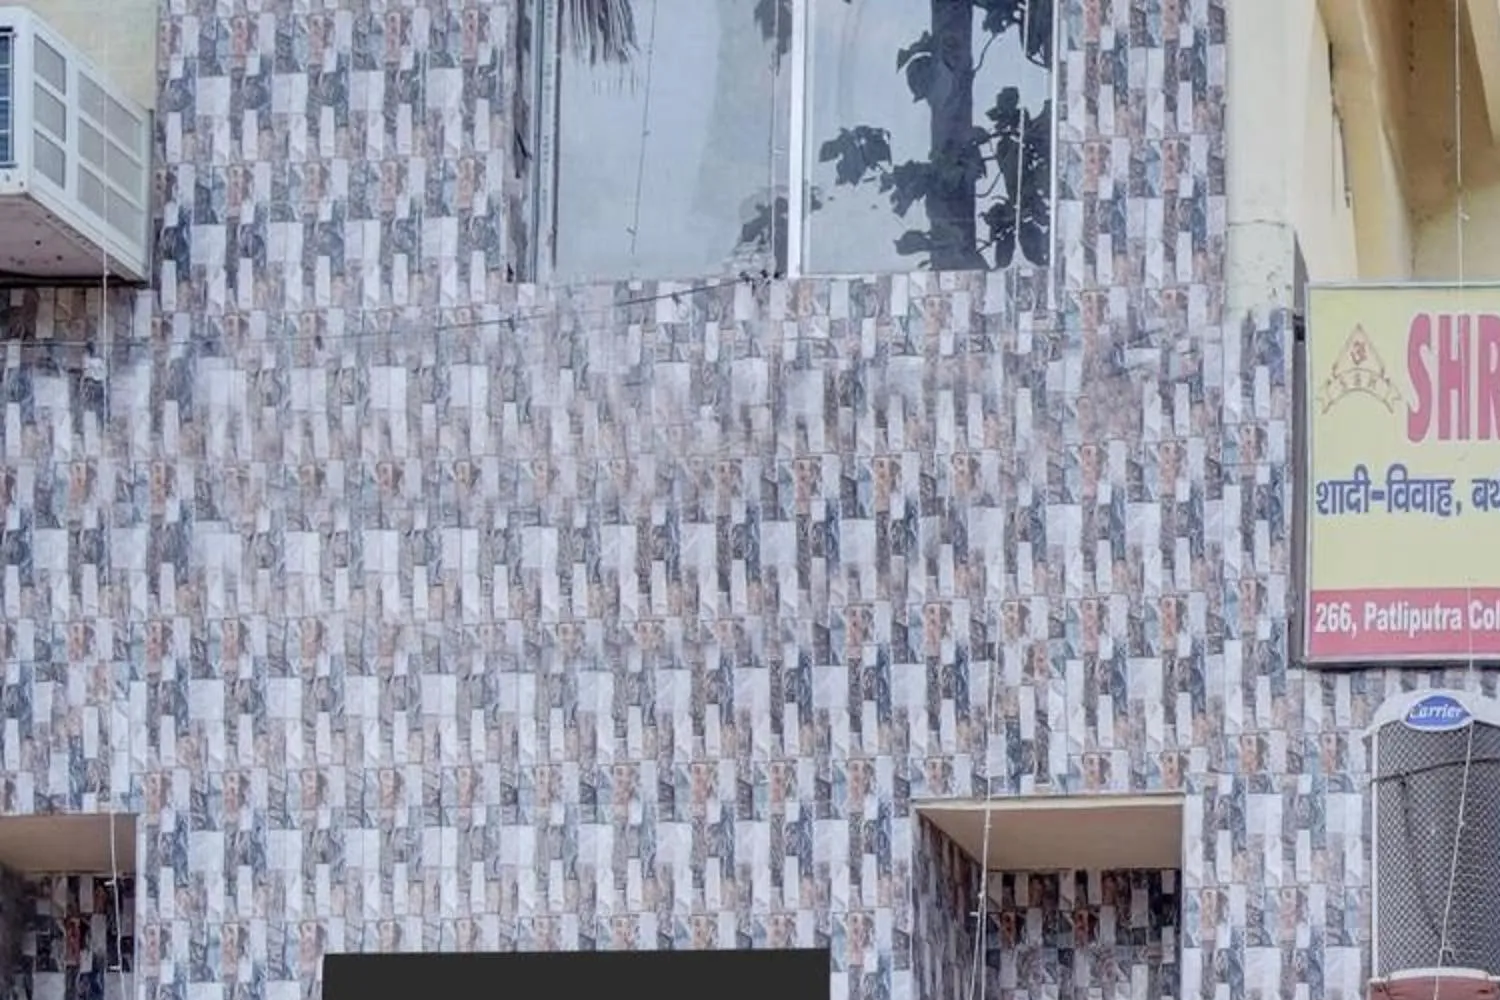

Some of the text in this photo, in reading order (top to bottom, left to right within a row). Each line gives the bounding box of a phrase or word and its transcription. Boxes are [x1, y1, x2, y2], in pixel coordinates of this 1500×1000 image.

[1315, 463, 1463, 517] शादी-विवाह,
[1315, 601, 1357, 637] 266,
[1364, 600, 1462, 638] Patliputra
[1409, 703, 1462, 719] Carrier
